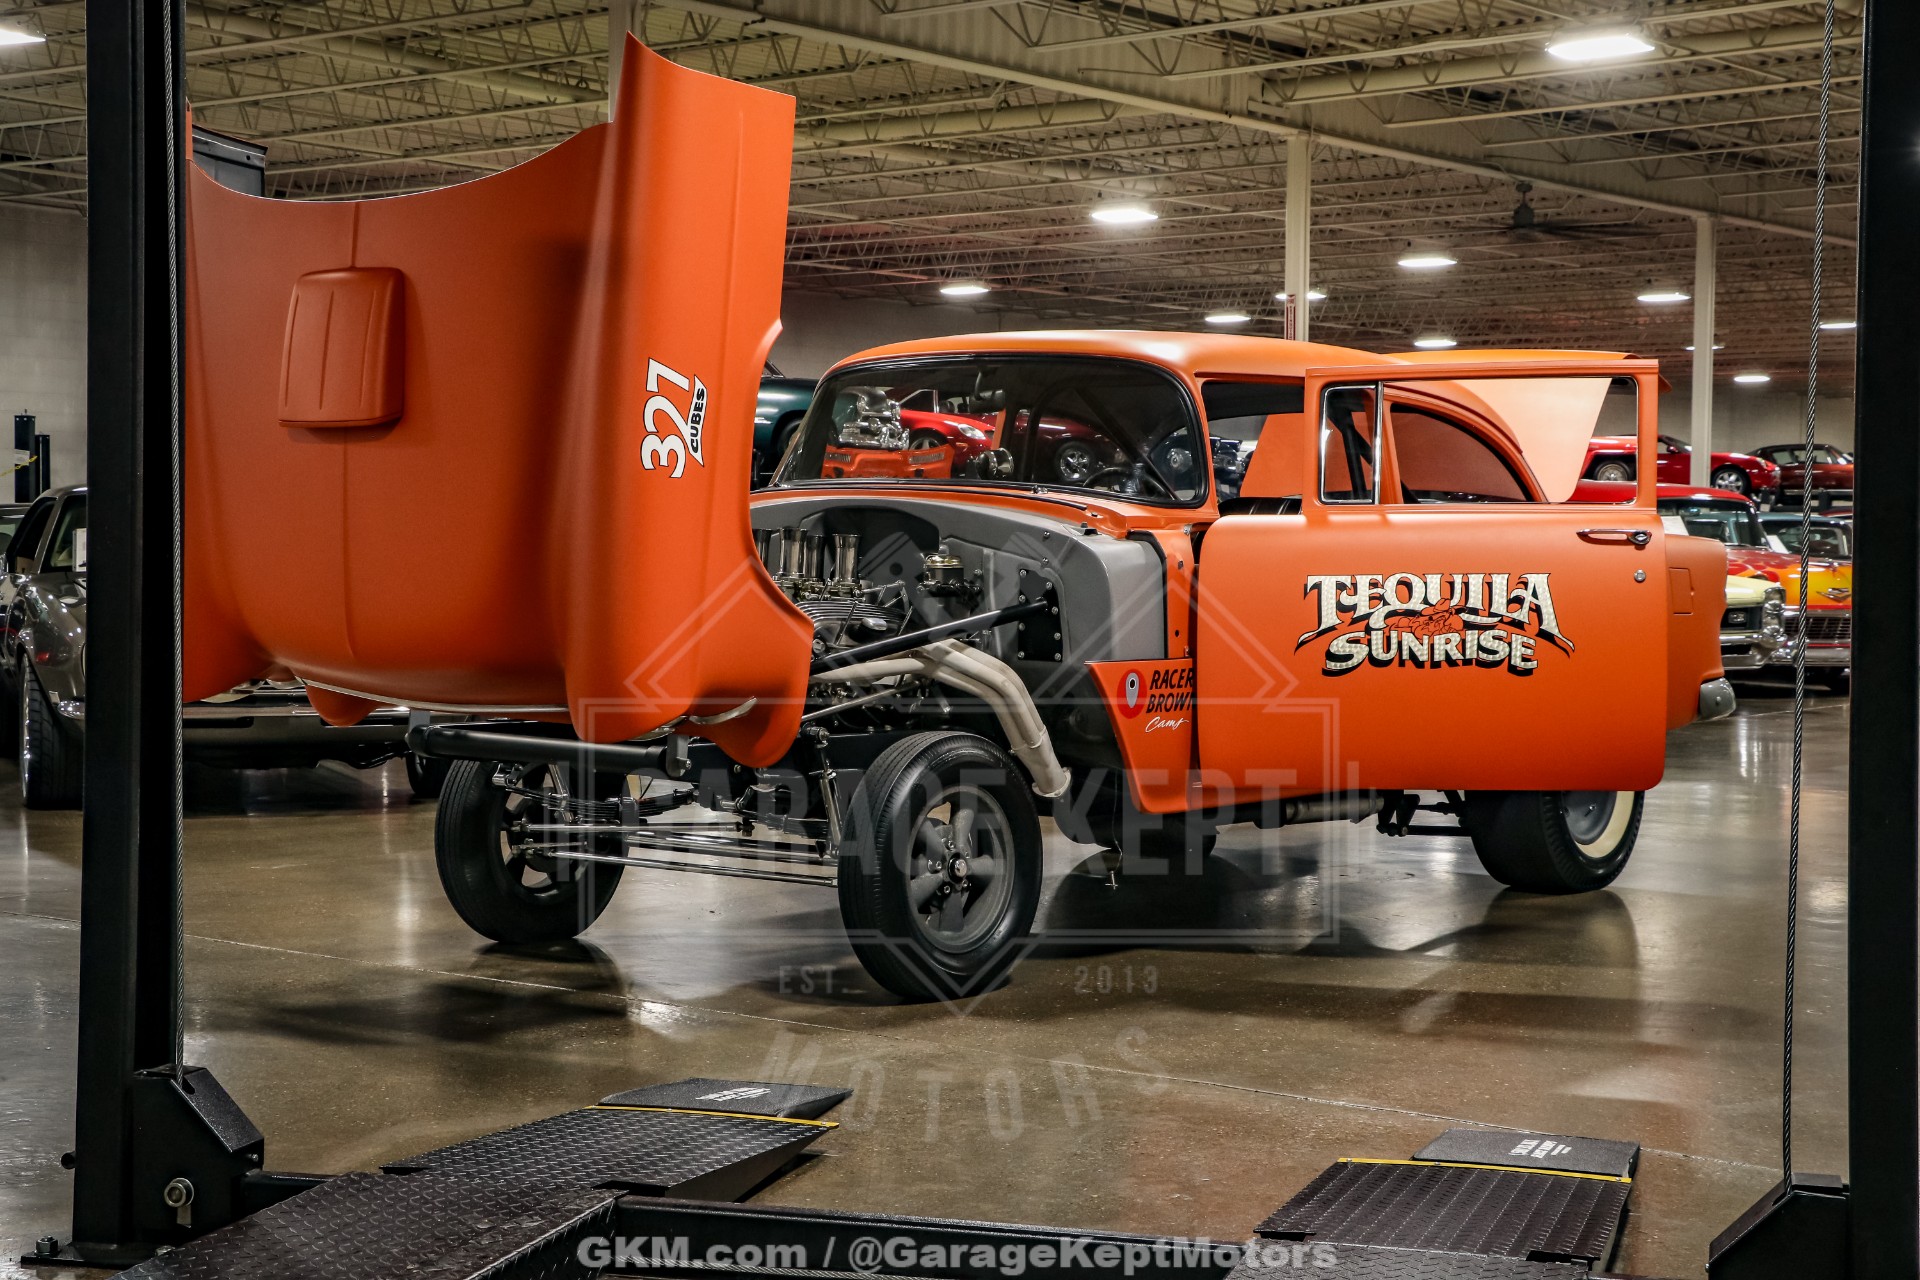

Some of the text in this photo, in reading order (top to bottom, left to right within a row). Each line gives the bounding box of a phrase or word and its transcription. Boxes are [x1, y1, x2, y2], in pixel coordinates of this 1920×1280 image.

[640, 357, 690, 478] 327
[690, 387, 705, 454] CUBES
[1296, 572, 1576, 656] TEQUILA
[1149, 668, 1194, 691] RACER
[1323, 628, 1539, 676] SUNRISE
